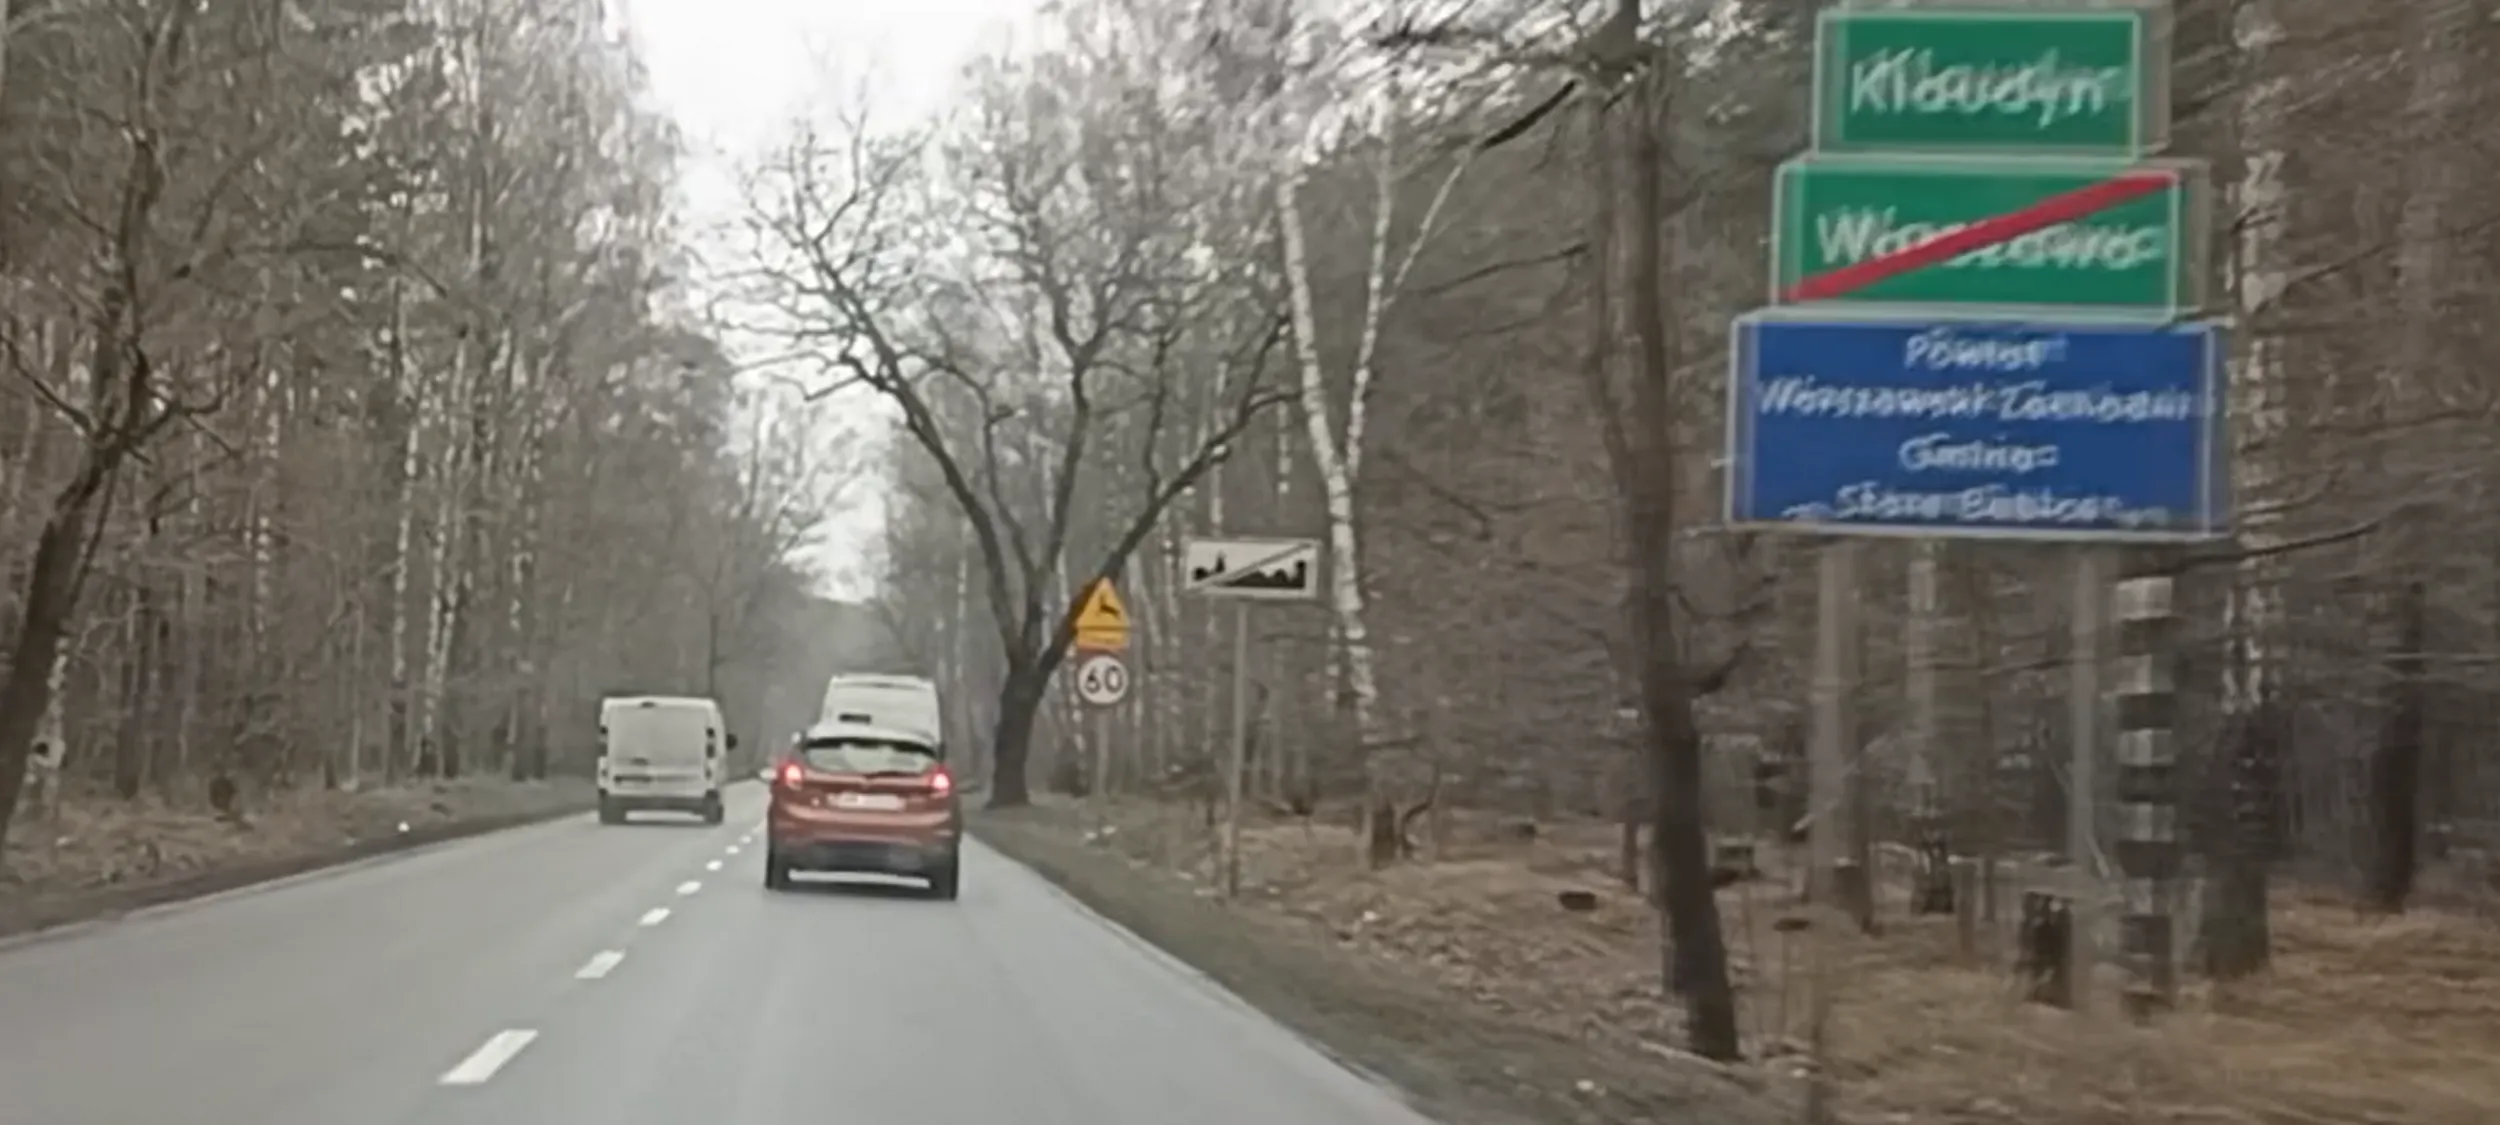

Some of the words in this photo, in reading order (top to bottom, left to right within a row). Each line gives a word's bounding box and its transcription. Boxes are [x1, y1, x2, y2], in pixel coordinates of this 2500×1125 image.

[1850, 47, 2121, 128] Klaudyn
[1815, 205, 2166, 270] Wazawa
[1085, 664, 1122, 694] 60
